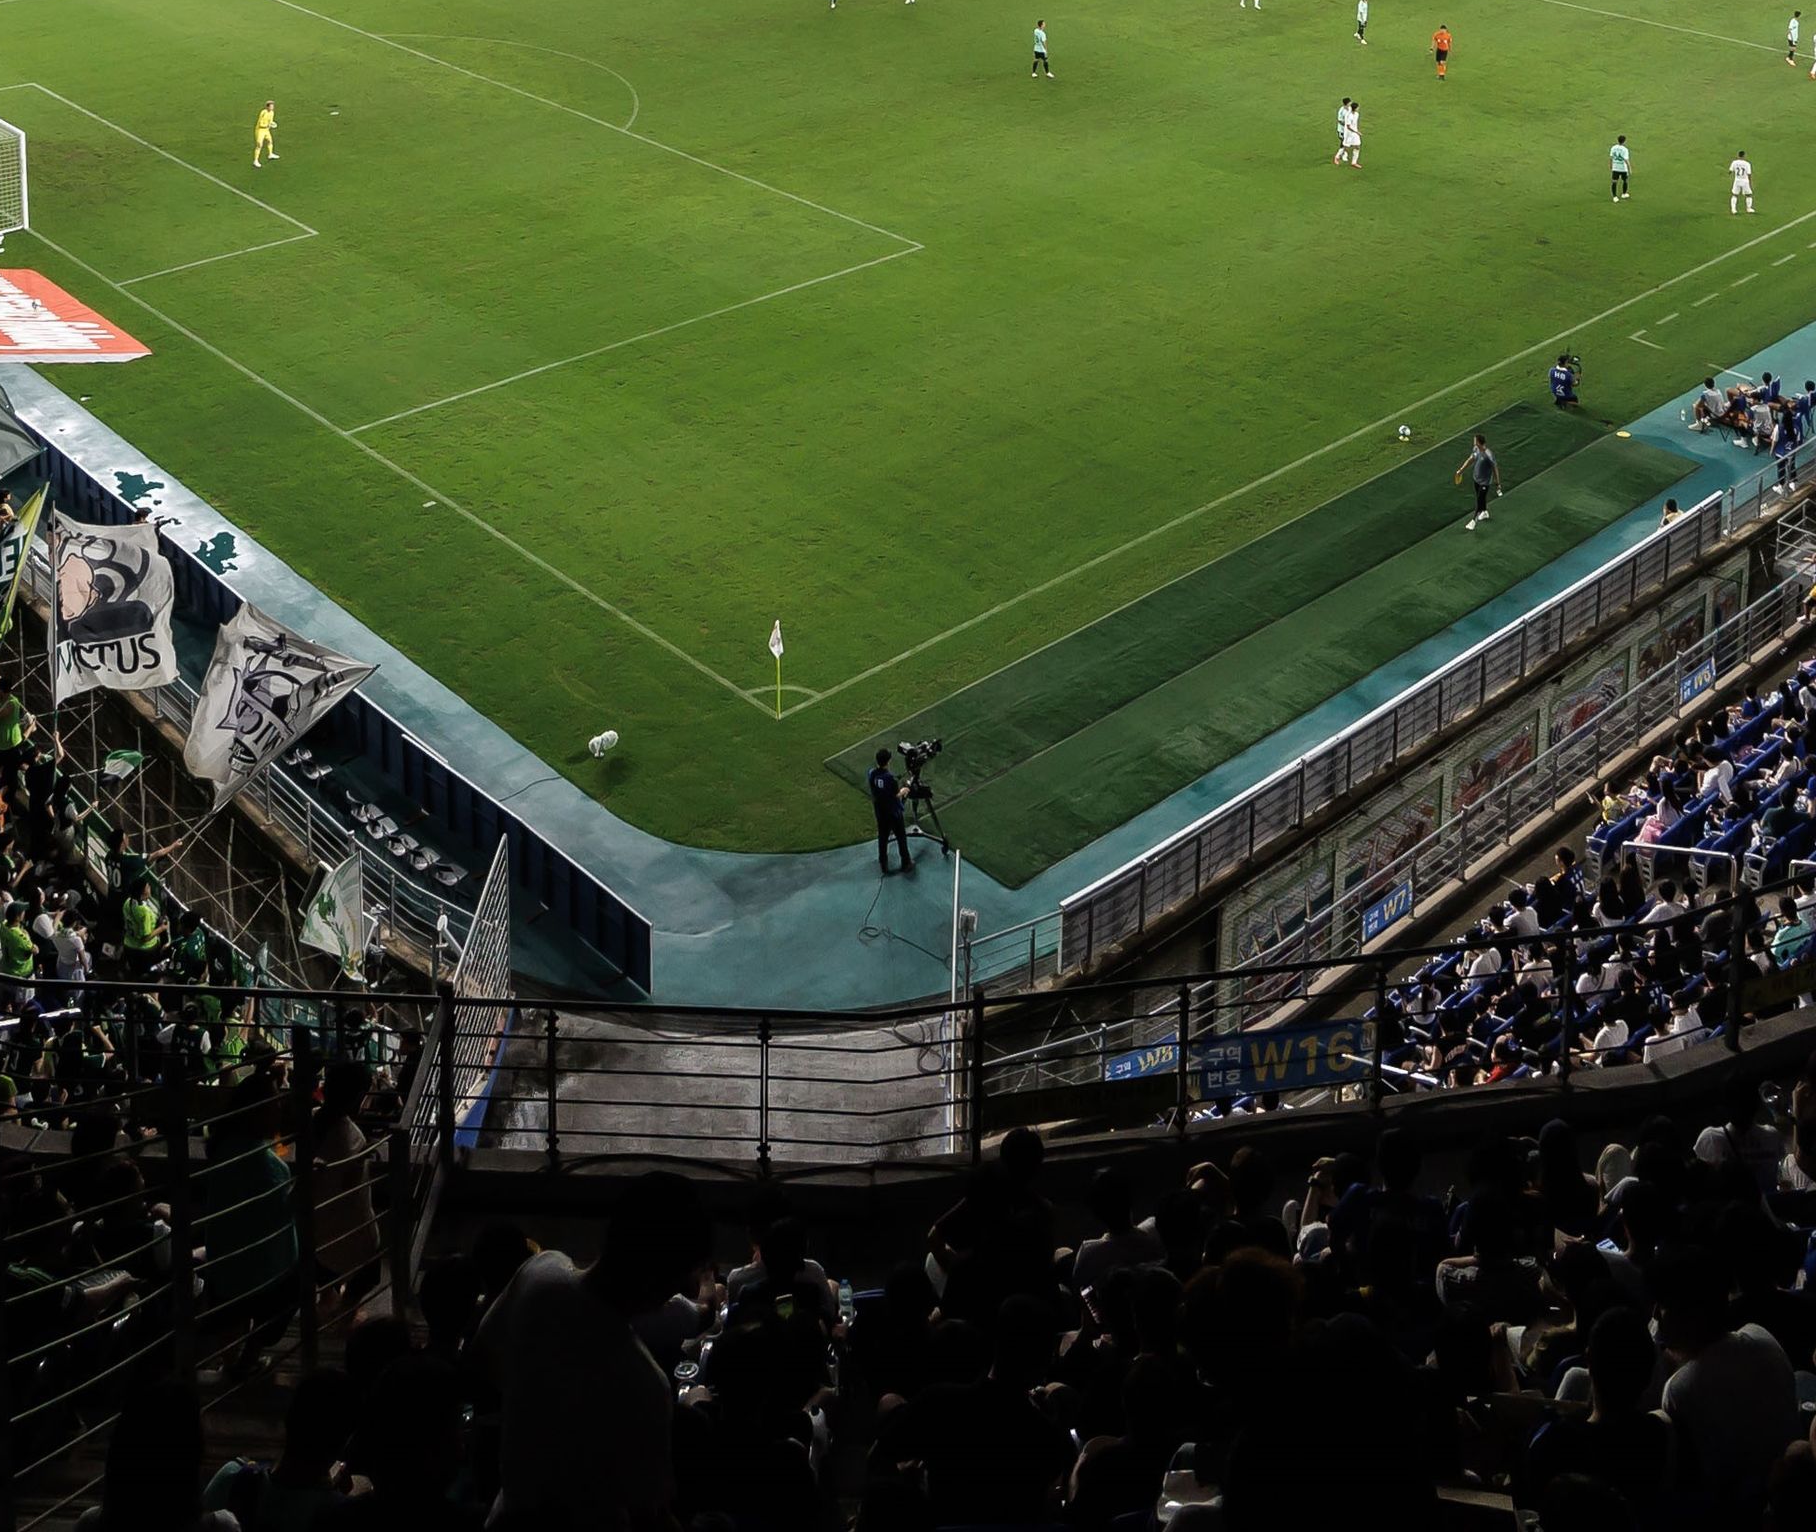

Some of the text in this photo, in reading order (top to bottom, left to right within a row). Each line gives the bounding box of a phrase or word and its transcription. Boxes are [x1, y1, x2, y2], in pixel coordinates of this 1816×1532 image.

[1383, 888, 1408, 922] W7
[1207, 1046, 1242, 1067] 구역
[1250, 1030, 1354, 1082] W16
[1207, 1068, 1242, 1089] 번호
